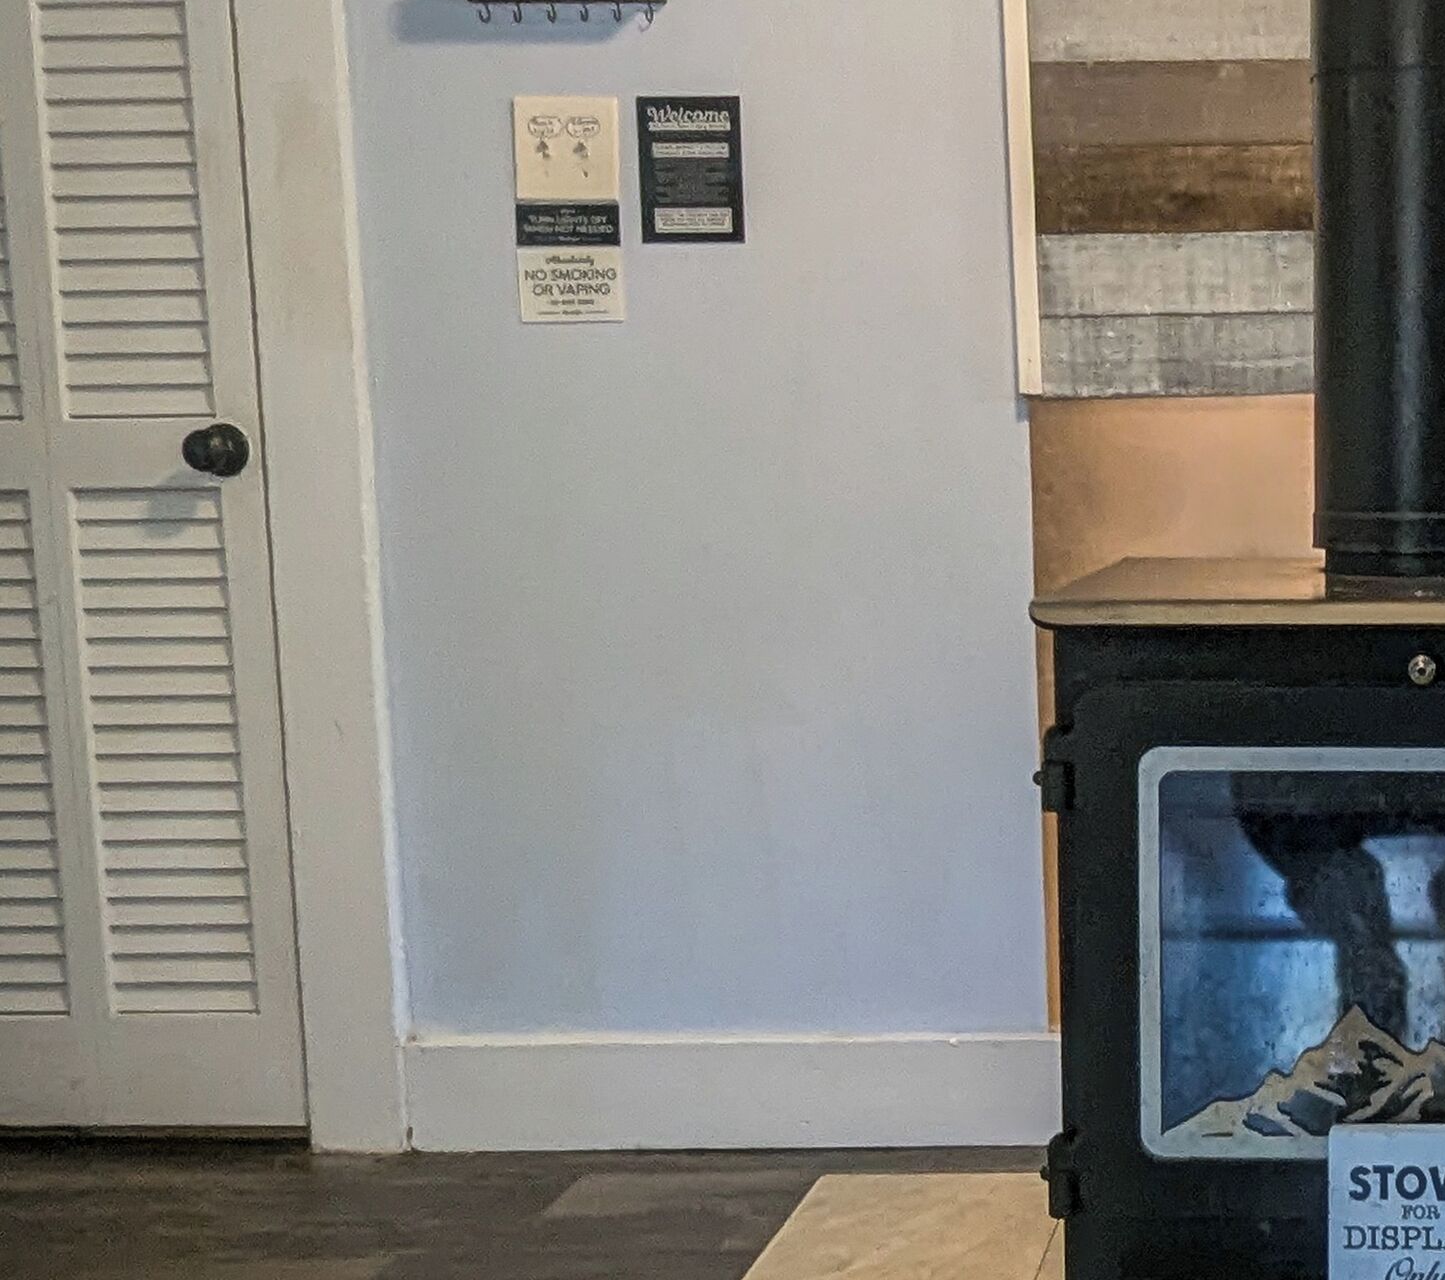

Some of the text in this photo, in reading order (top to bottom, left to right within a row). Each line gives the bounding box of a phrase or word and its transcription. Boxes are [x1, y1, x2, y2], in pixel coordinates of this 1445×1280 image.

[646, 104, 730, 125] Welcome
[524, 267, 617, 281] NO SMOKING
[532, 283, 611, 296] OR VAPING
[1401, 1204, 1441, 1220] FOR
